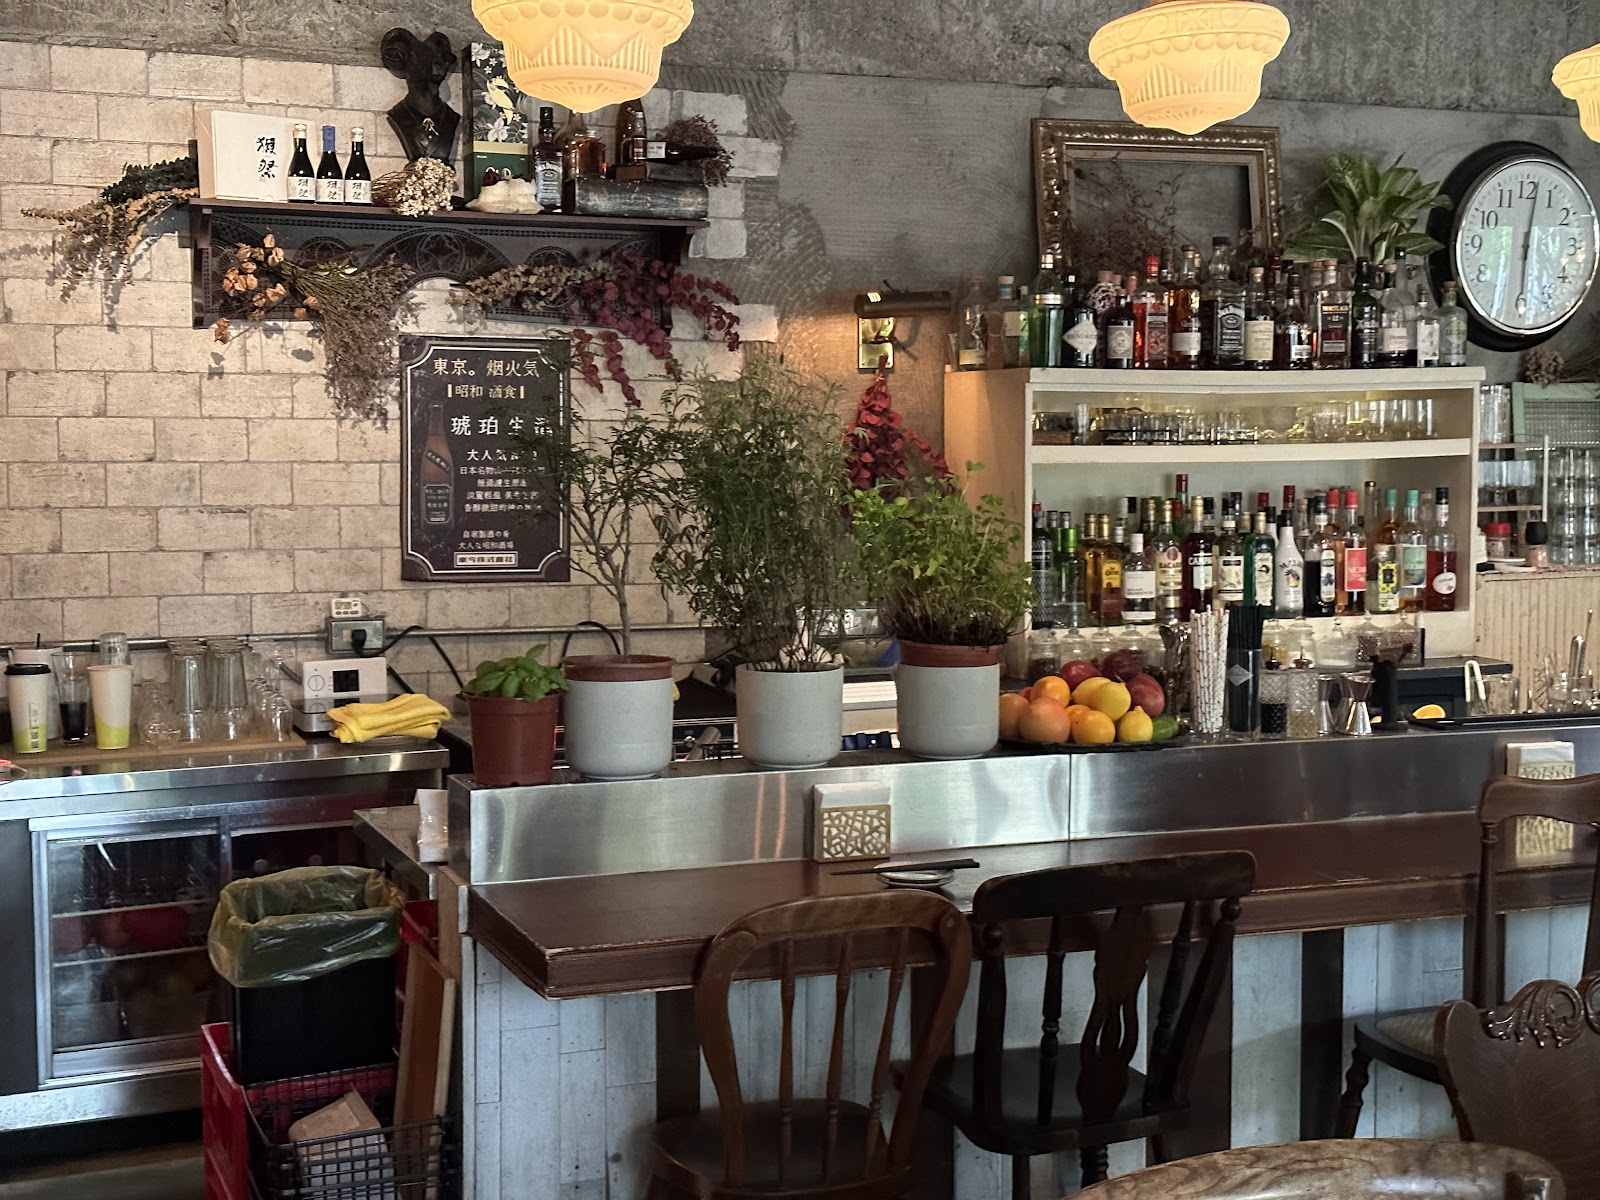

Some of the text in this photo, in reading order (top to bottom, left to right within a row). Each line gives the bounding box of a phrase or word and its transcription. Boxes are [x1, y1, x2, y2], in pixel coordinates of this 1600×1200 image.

[1497, 188, 1514, 209] 11
[1518, 180, 1537, 200] 12
[1545, 189, 1553, 208] 1
[1479, 210, 1499, 230] 10
[1558, 207, 1570, 226] 2
[1470, 234, 1483, 255] 9
[1567, 237, 1578, 256] 3
[1476, 264, 1488, 283] 8
[1557, 265, 1569, 283] 4
[433, 357, 540, 378] 東京。 烟火気
[454, 384, 517, 399] 昭和 酒食
